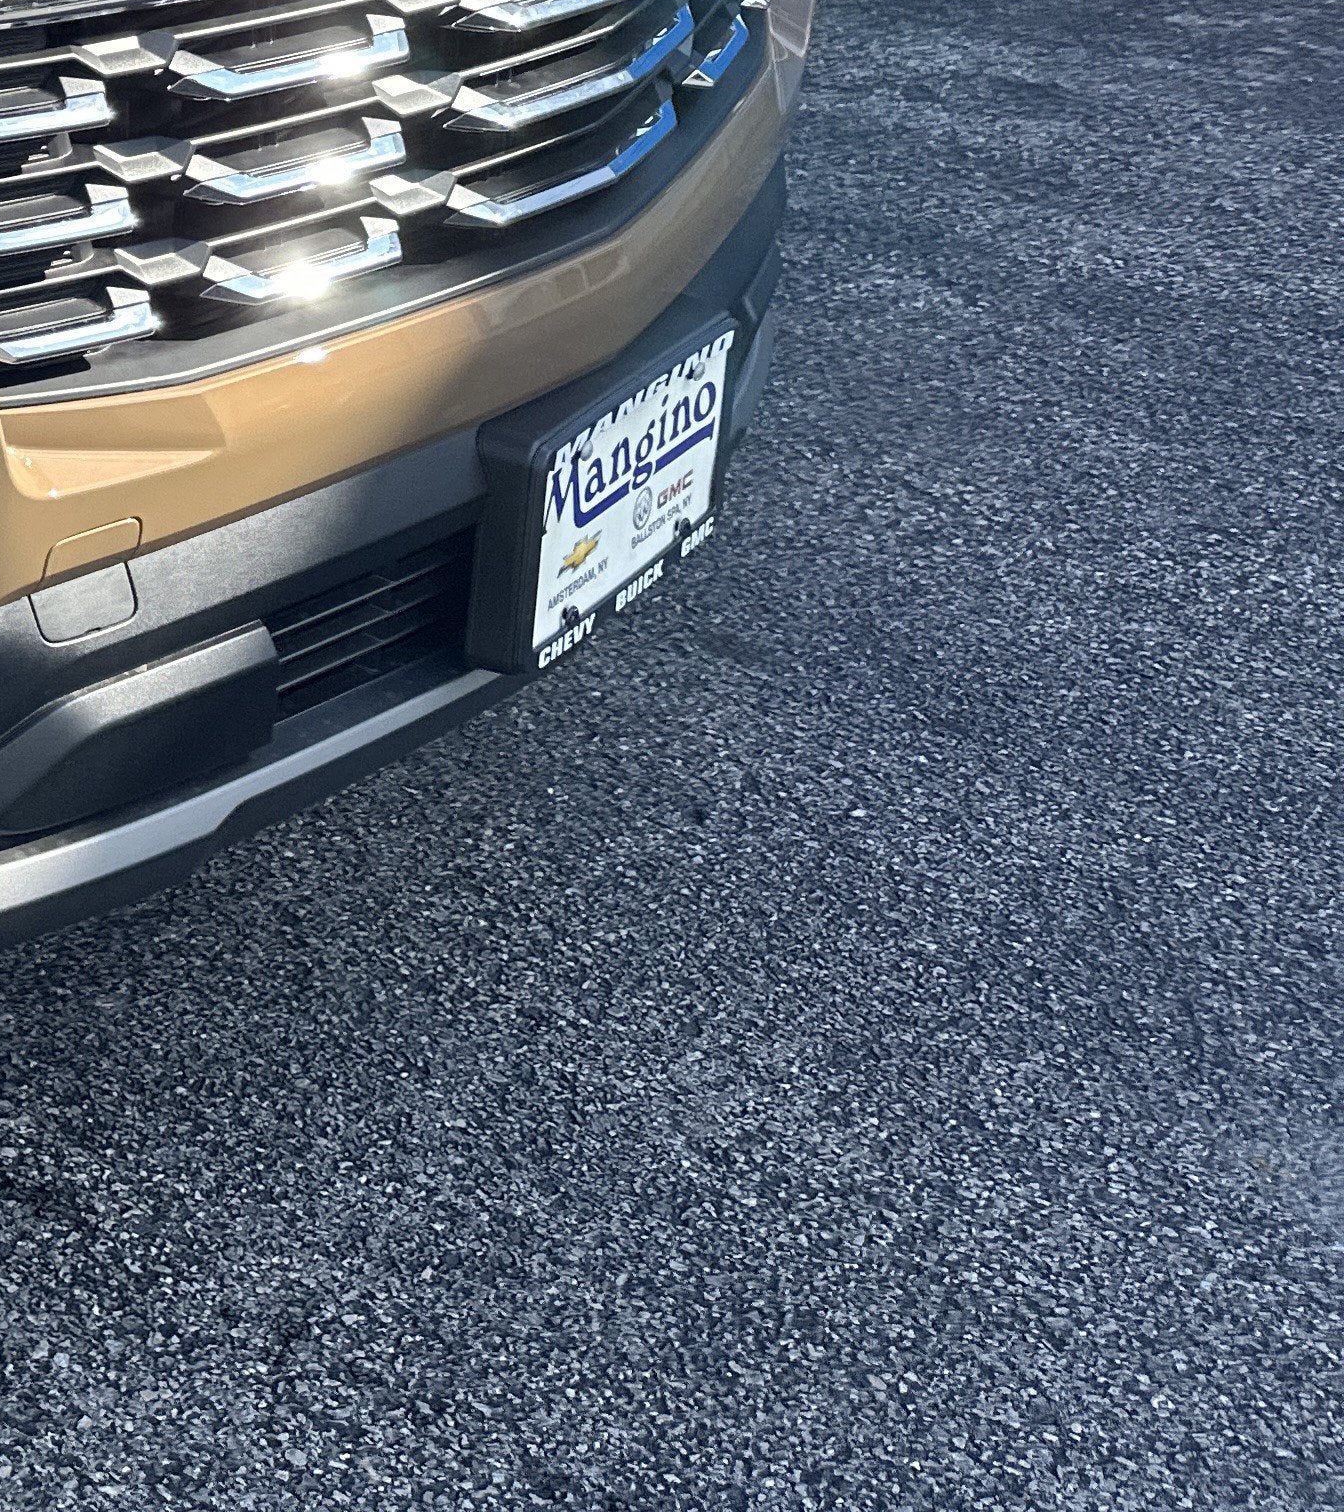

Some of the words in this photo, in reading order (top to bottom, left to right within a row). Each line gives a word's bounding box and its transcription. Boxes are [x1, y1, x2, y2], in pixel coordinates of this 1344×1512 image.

[543, 381, 718, 534] Mangino
[657, 469, 695, 510] GMC
[631, 514, 667, 550] BALLSTON
[682, 492, 693, 508] NY
[538, 612, 596, 669] CHEVY
[615, 558, 664, 612] BUICK
[681, 516, 715, 558] GMC
[547, 567, 597, 612] AMSTERDAM,
[598, 556, 609, 575] NY
